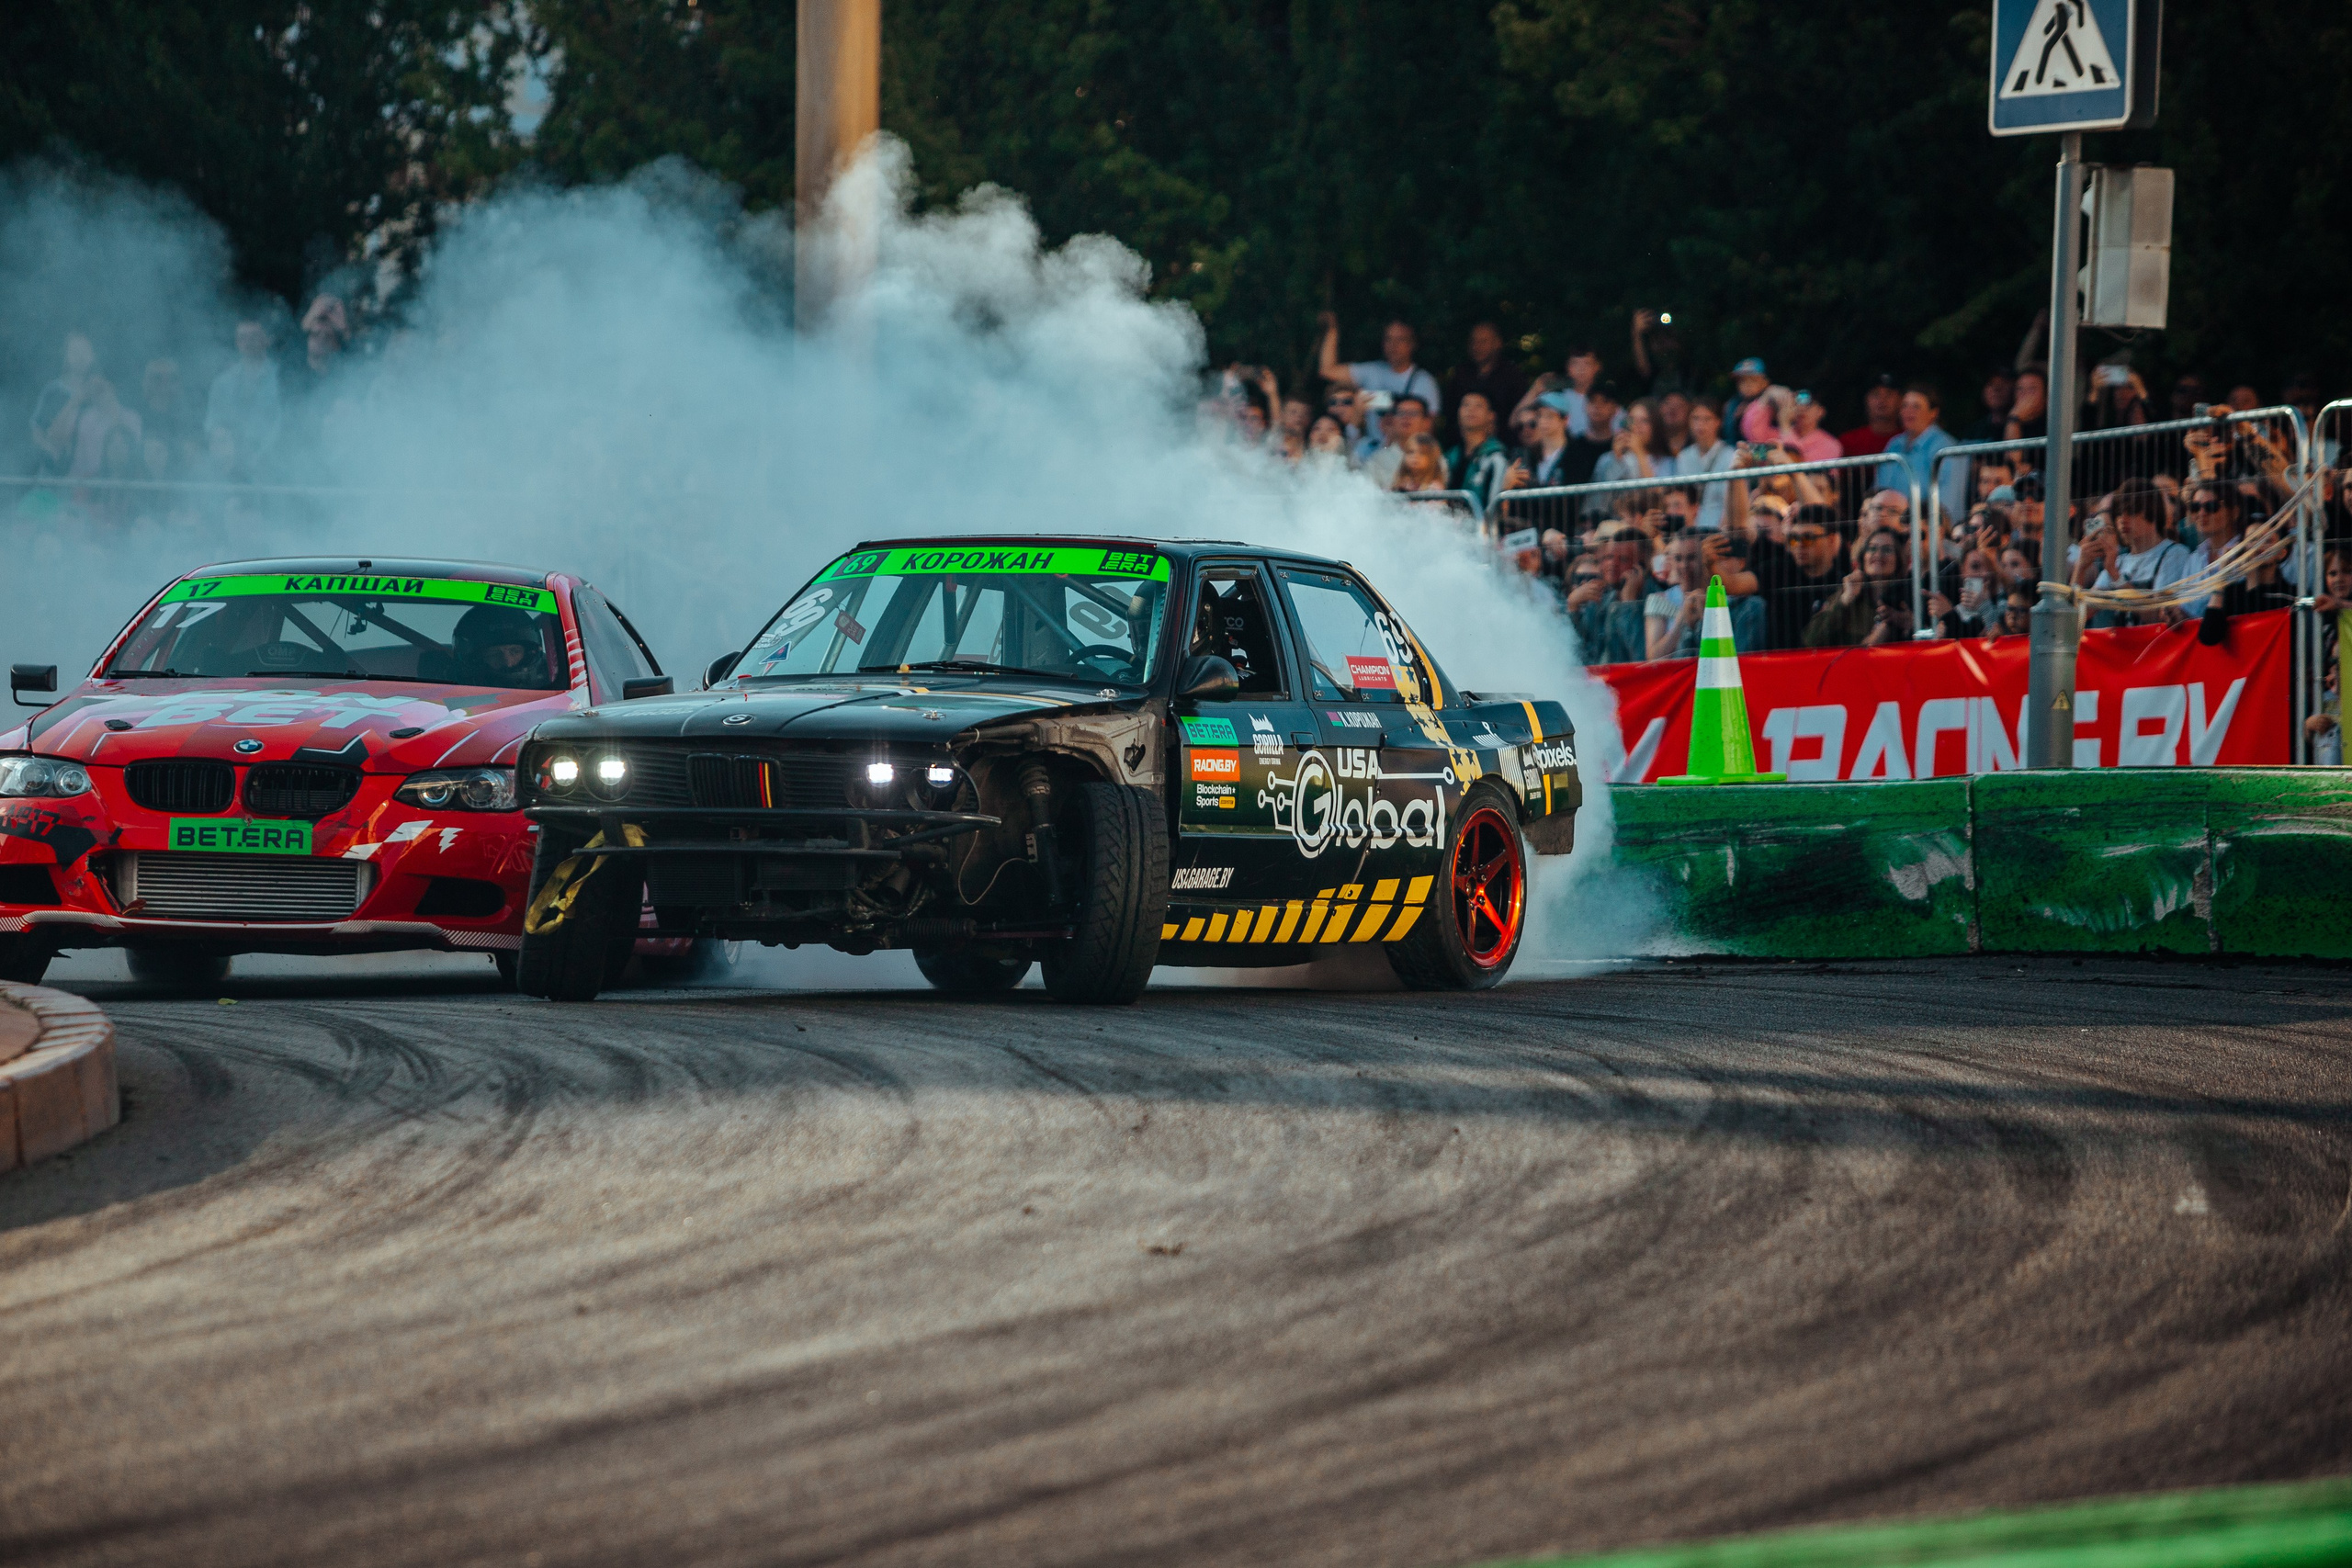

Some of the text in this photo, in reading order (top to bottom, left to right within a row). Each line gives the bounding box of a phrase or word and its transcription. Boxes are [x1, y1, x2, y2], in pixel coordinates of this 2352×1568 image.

[842, 554, 869, 573] 69
[900, 552, 1056, 570] КОРОЖАН
[1108, 552, 1154, 563] BET
[187, 581, 222, 597] 17
[492, 586, 534, 599] BET
[152, 603, 227, 628] 17
[774, 587, 833, 637] 69
[1374, 610, 1414, 664] 69
[1350, 663, 1391, 675] CHAMPION
[134, 704, 403, 728] BET
[1761, 677, 2246, 781] RACINBY
[1252, 733, 1284, 755] GORILLA
[1193, 759, 1237, 773] RACING.BY
[1337, 747, 1381, 780] USA
[1196, 784, 1232, 795] Blockchain
[1195, 795, 1219, 808] Sports
[1296, 762, 1445, 850] Global
[176, 827, 304, 849] BET.ERA
